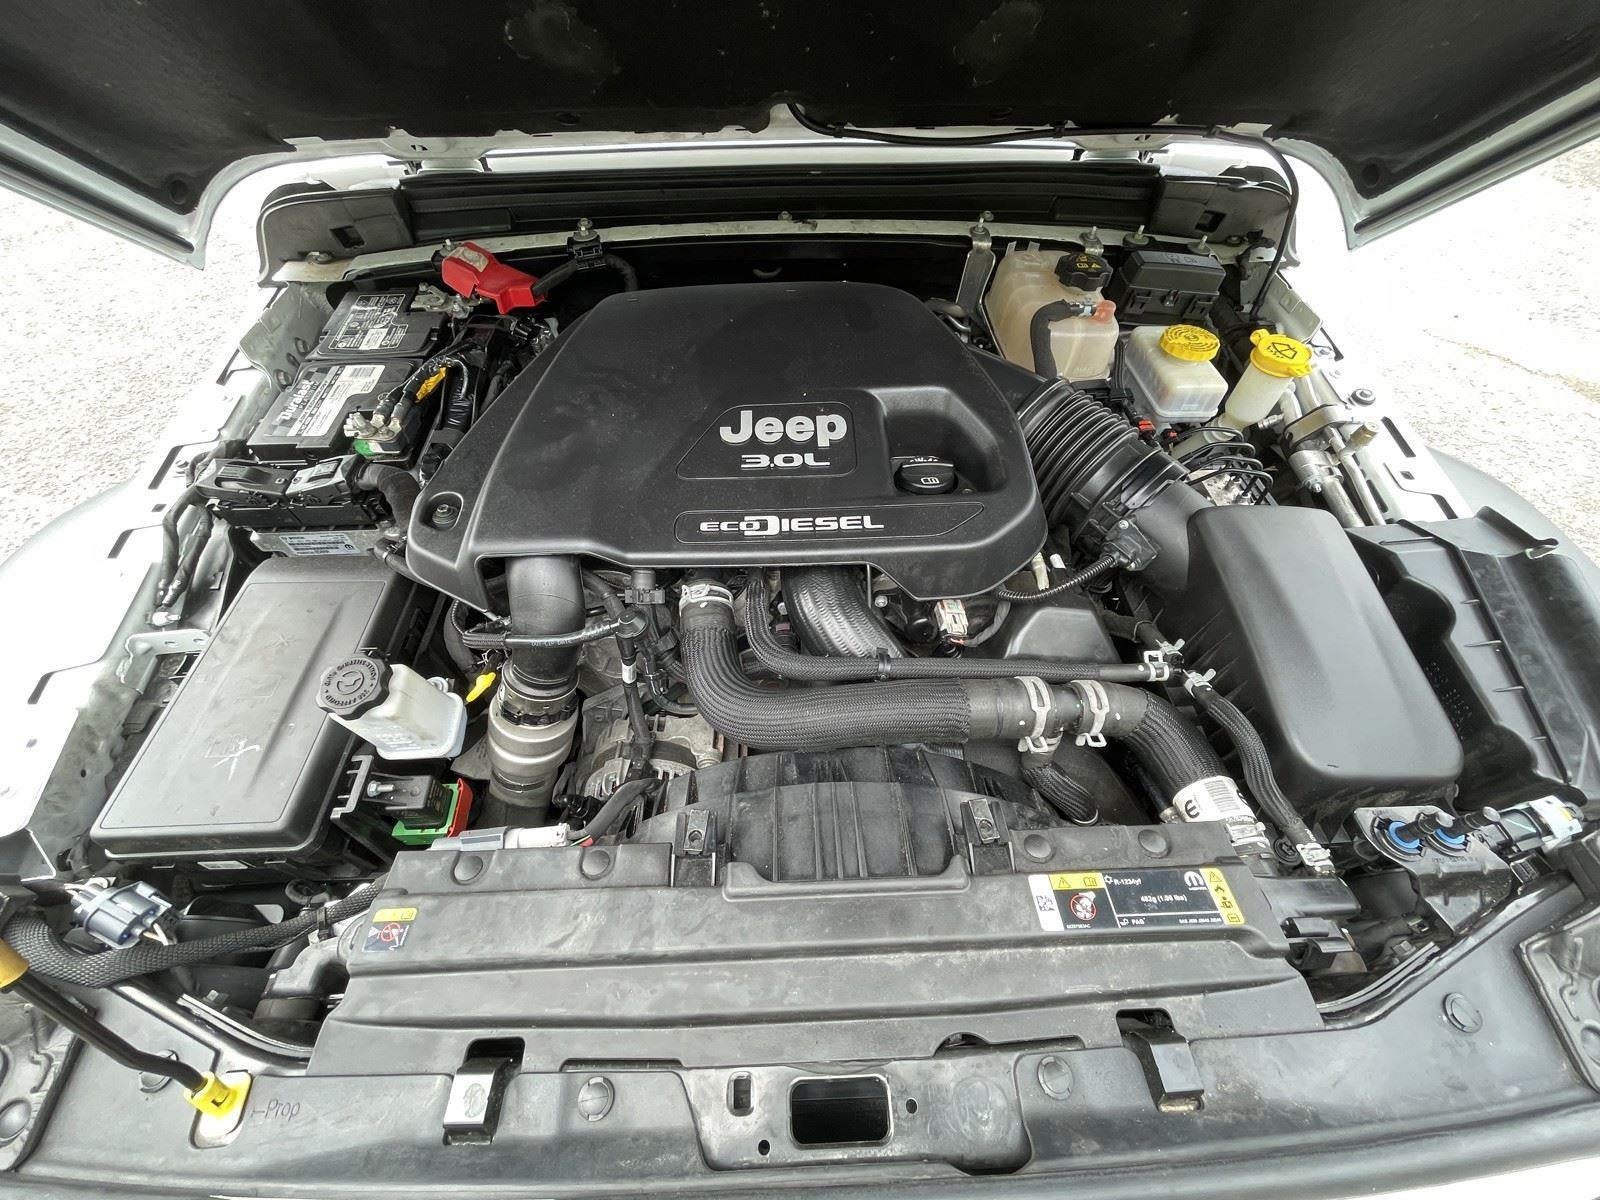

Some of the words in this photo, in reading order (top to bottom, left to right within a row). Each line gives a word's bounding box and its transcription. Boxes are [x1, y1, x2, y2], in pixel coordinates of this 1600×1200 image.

[276, 379, 315, 422] Duralast
[719, 410, 848, 448] Jeep
[740, 452, 831, 468] 3.0L
[264, 1098, 301, 1122] Prop
